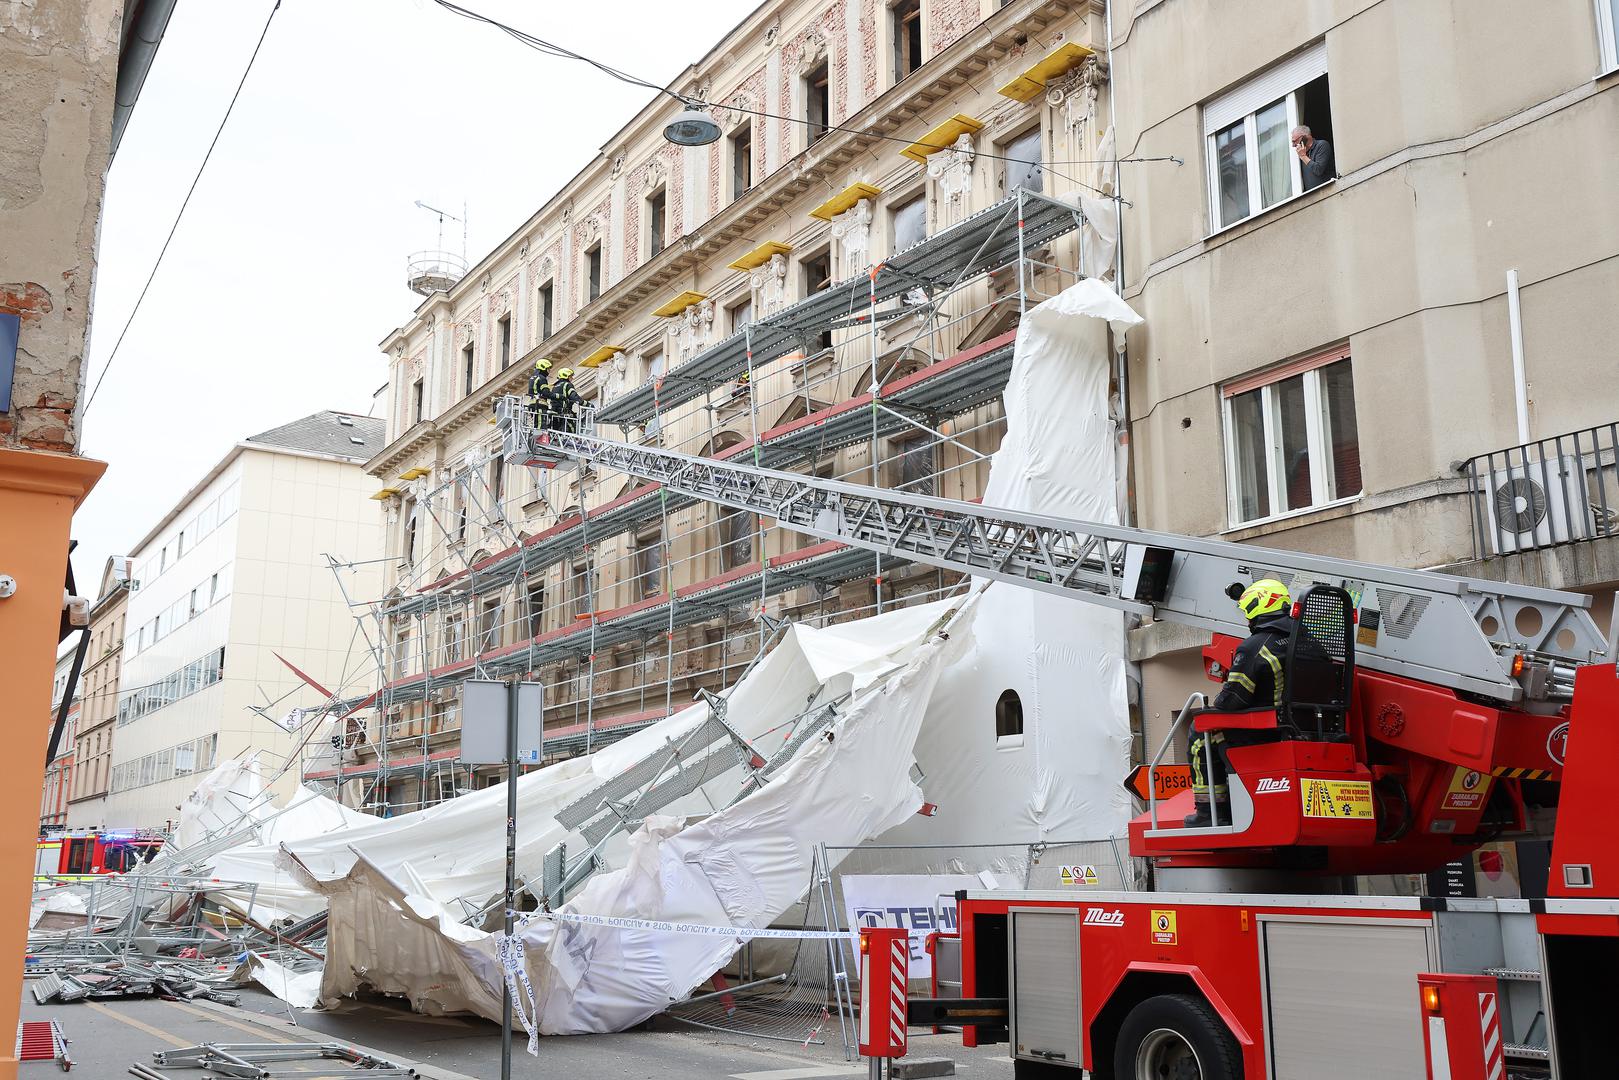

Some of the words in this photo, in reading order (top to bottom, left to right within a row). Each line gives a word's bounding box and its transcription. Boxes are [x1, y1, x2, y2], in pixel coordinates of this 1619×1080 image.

[1153, 772, 1193, 793] Pješac
[1255, 777, 1291, 794] Metz
[886, 907, 957, 929] TEH
[1082, 908, 1125, 927] Metz
